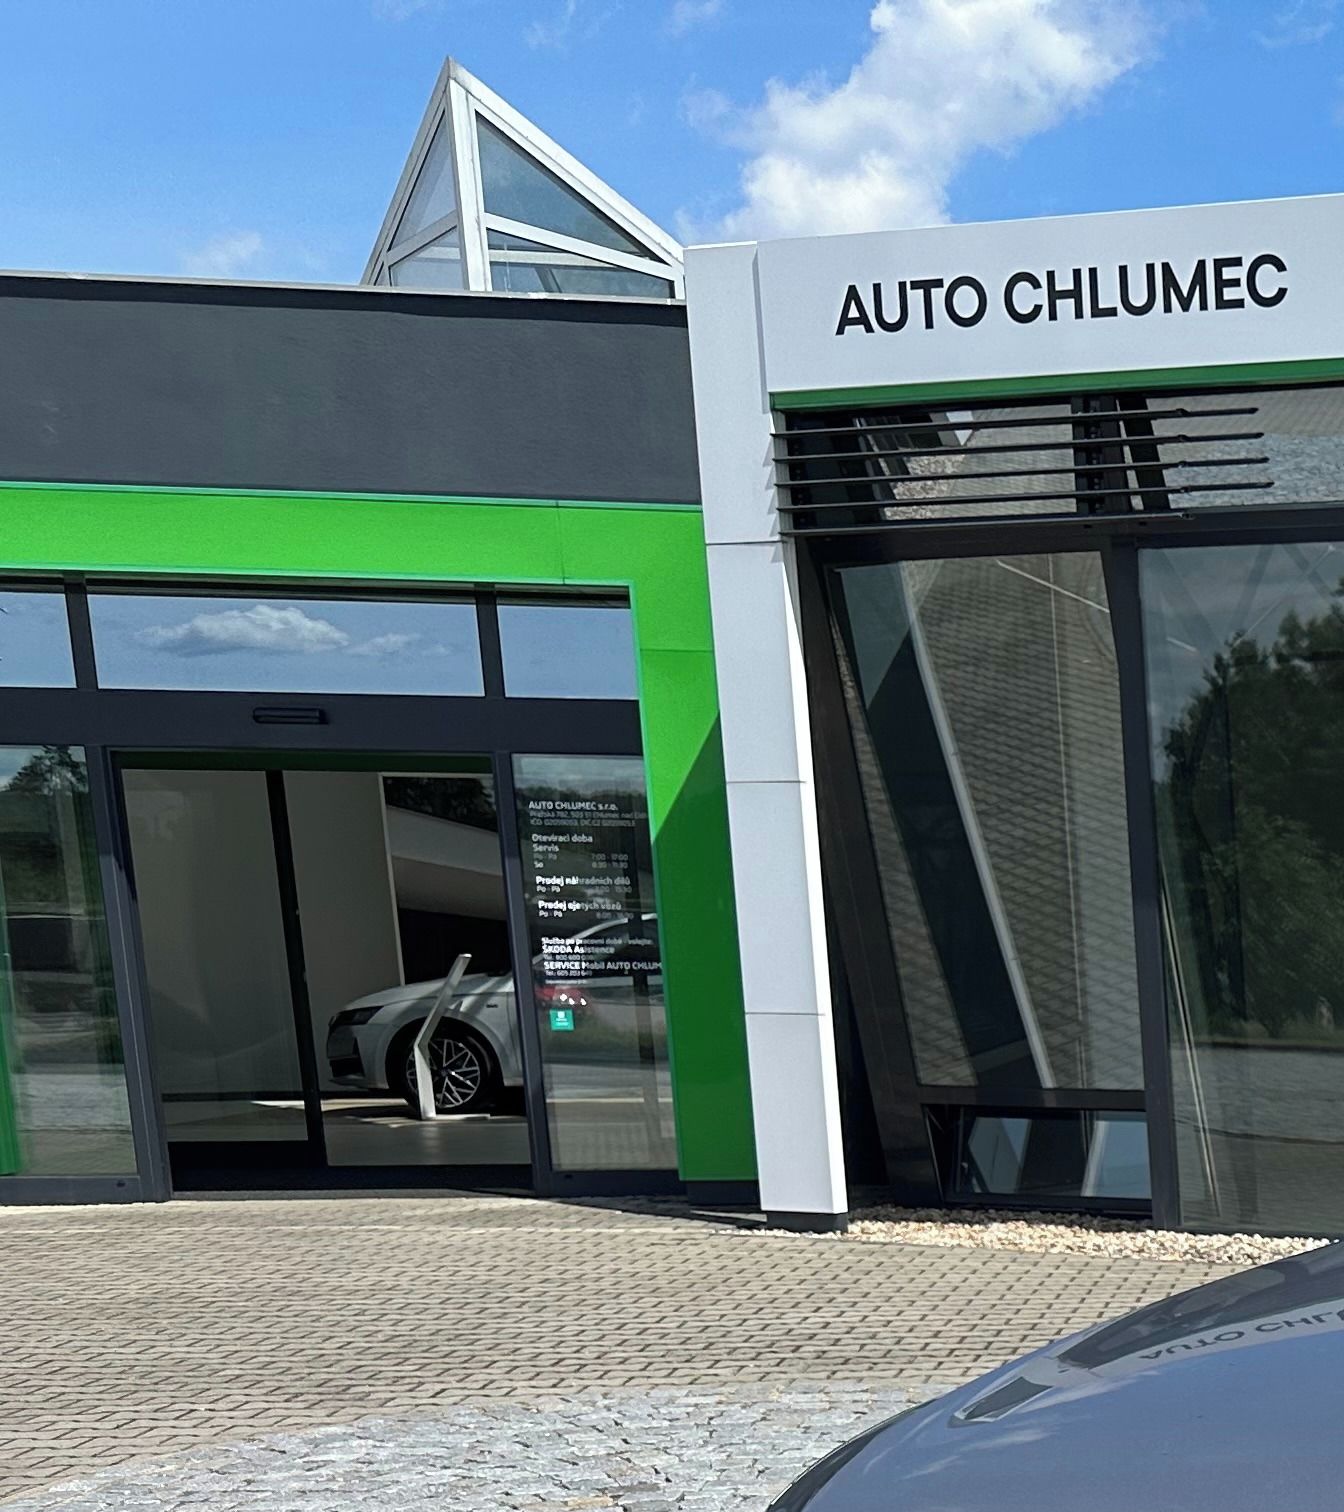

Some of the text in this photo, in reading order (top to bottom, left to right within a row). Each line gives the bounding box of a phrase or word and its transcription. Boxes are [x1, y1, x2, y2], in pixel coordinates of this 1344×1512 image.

[834, 253, 1289, 337] AUTO CHLUMEC
[528, 801, 618, 811] AUTO CHLUMEC s.r.o.
[571, 833, 593, 843] doba
[532, 843, 559, 852] Servis
[533, 860, 544, 869] So
[535, 875, 565, 887] Prodej
[565, 875, 613, 885] náhradních
[538, 900, 567, 911] Prodej
[542, 944, 573, 953] ŠKODA
[543, 961, 580, 970] SERVICE
[581, 961, 605, 970] Mobil
[606, 961, 631, 970] AUTO
